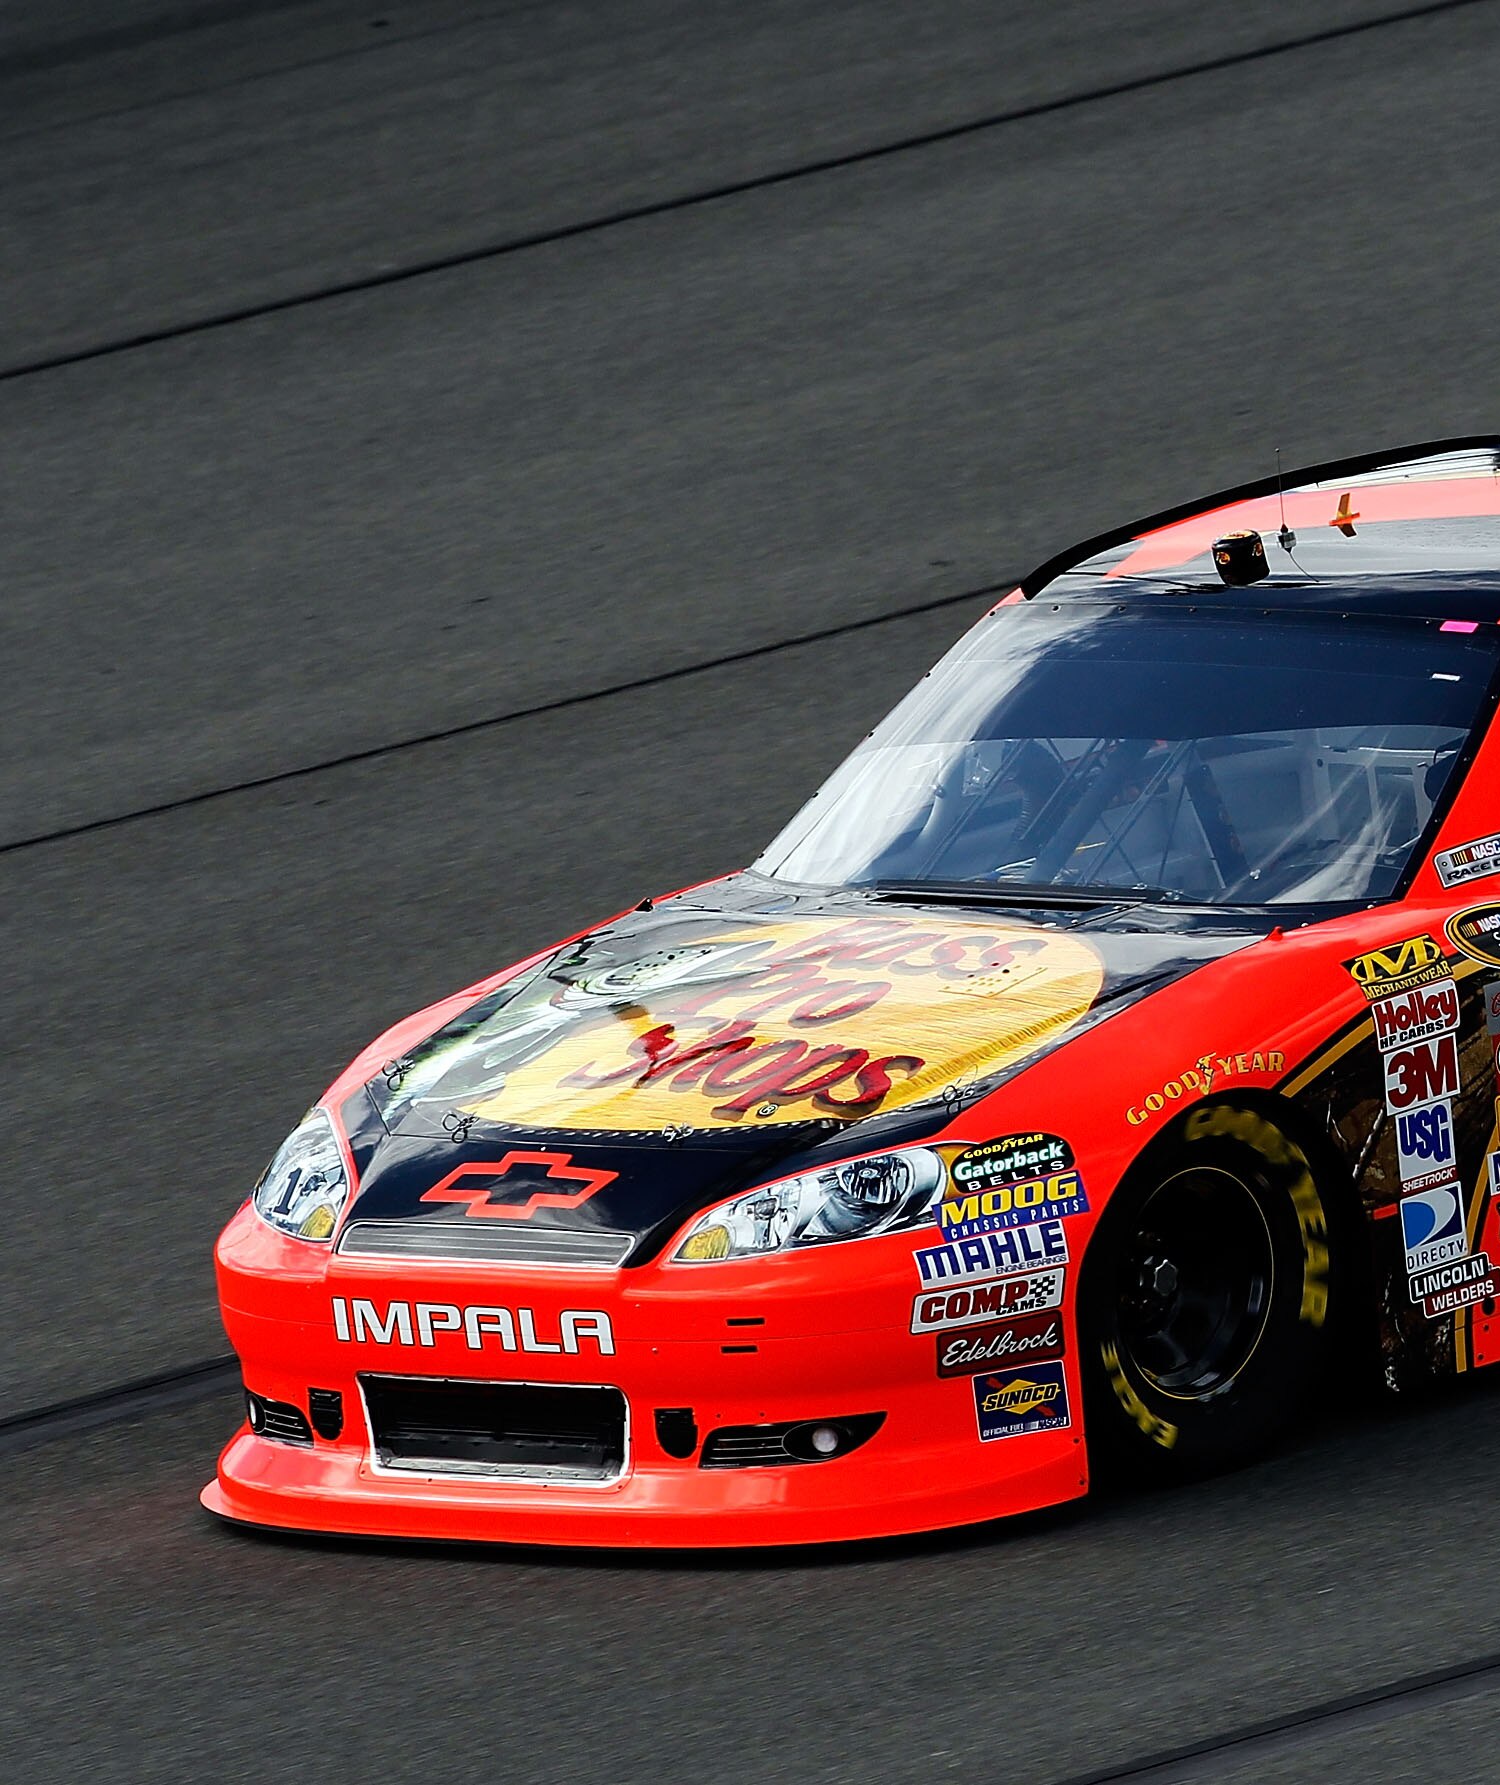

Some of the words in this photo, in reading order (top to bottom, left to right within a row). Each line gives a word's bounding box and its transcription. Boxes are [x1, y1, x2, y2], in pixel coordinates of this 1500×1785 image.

[1447, 862, 1490, 880] RACE
[653, 962, 892, 1033] Pro
[1361, 977, 1420, 1000] MECHANIX
[1420, 960, 1452, 983] WEAR
[1375, 989, 1458, 1038] Holley
[1380, 1034, 1398, 1050] HP
[1400, 1020, 1444, 1043] CARBS
[556, 1021, 925, 1120] Shops
[1387, 1037, 1458, 1109] 3M
[963, 1133, 1043, 1160] GOODYEAR
[1398, 1104, 1451, 1162] USG
[954, 1142, 1064, 1181] Gatorback
[967, 1160, 1065, 1191] BELTS
[1402, 1167, 1455, 1193] SHEETROCK
[272, 1166, 303, 1216] 1
[941, 1172, 1077, 1228] MOOG
[951, 1213, 1019, 1239] CHASSIS
[1031, 1203, 1079, 1221] PARTS
[915, 1221, 1065, 1280] MAHLE
[996, 1260, 1026, 1275] ENGINE
[1027, 1254, 1067, 1270] BEARINGS
[1407, 1239, 1465, 1269] DIRECTV
[1414, 1258, 1485, 1297] LINCOLN
[1431, 1279, 1494, 1311] WELDERS
[920, 1280, 1029, 1323] COMP
[996, 1297, 1047, 1316] CAMS
[332, 1297, 615, 1356] IMPALA
[942, 1322, 1058, 1366] Edelbrock
[984, 1383, 1057, 1411] SUNOCO
[983, 1426, 1008, 1437] OFFICIAL
